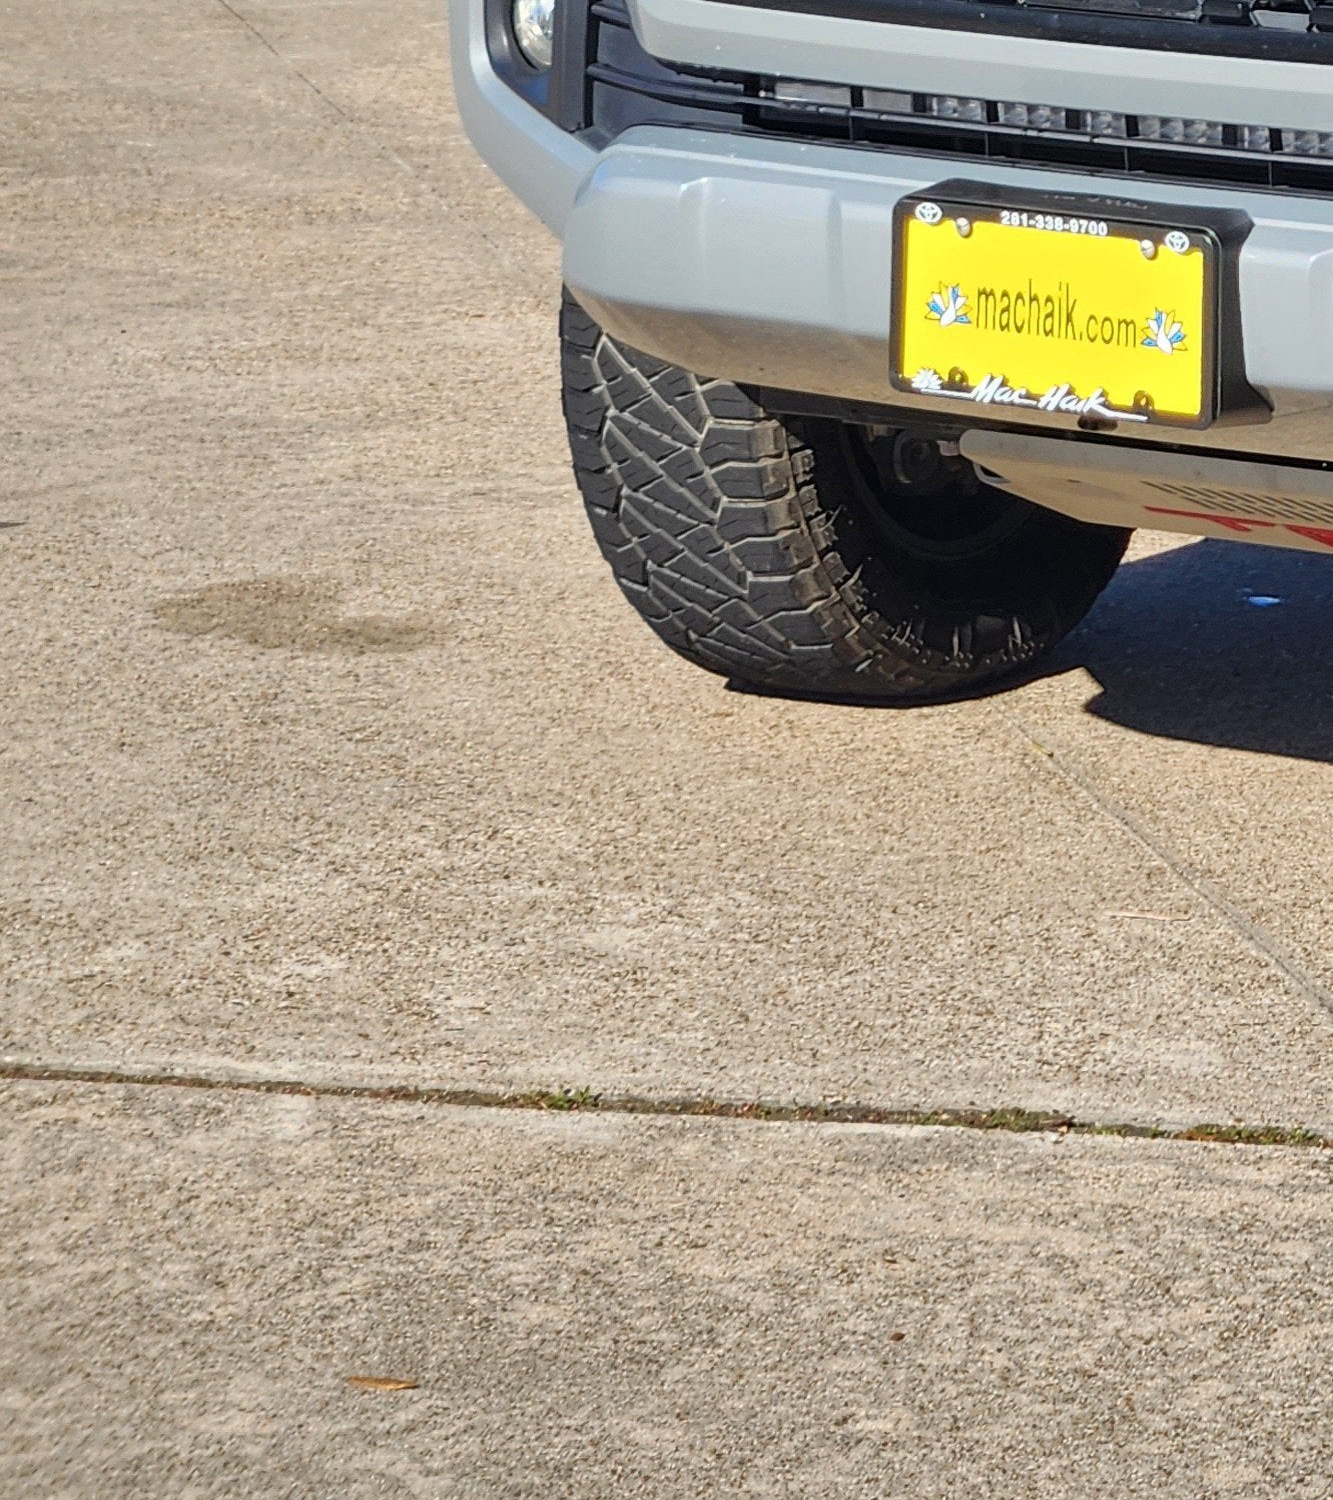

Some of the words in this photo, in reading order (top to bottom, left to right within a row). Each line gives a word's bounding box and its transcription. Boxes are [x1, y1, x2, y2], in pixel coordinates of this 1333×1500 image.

[976, 278, 1137, 348] machaik.com
[970, 373, 1038, 405] Mac
[1038, 383, 1113, 415] Haik
